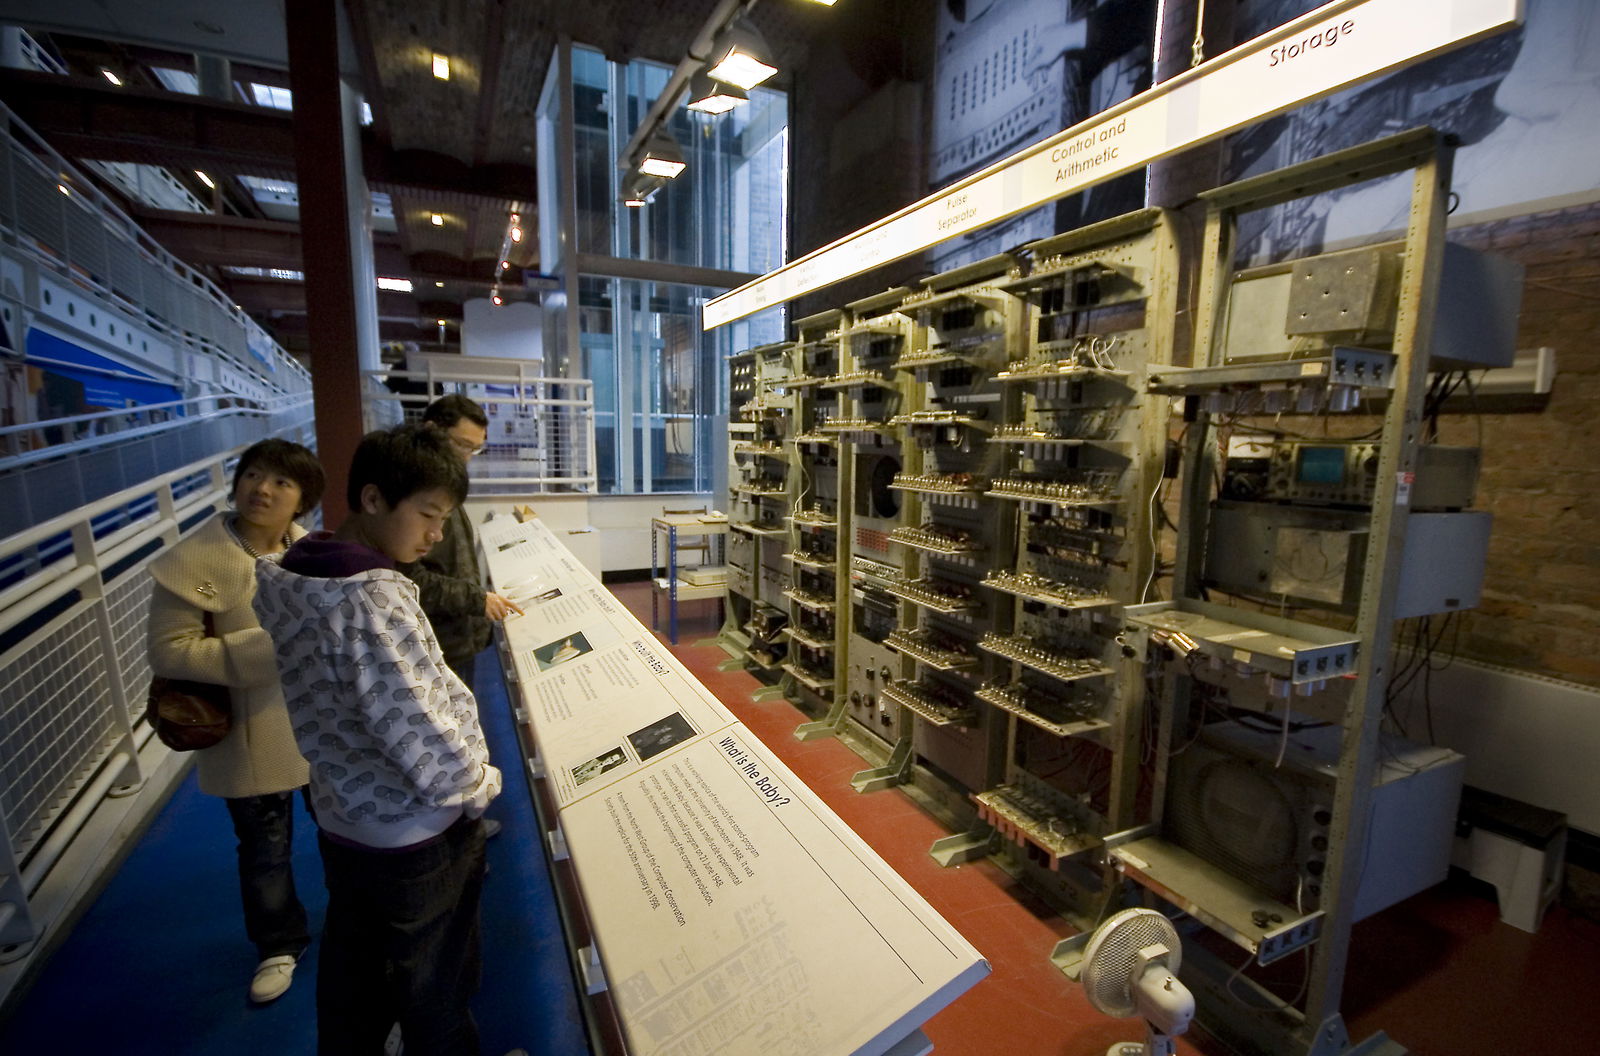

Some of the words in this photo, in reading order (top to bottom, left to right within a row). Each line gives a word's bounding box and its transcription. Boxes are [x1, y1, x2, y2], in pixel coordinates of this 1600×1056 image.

[1269, 20, 1354, 67] Storage
[1052, 132, 1096, 163] Control
[1099, 118, 1126, 142] and
[1056, 146, 1119, 182] Arithmetic
[938, 207, 977, 231] Separator
[719, 736, 744, 758] What
[735, 754, 748, 765] is
[742, 762, 760, 779] the
[755, 776, 791, 807] Baby?
[716, 803, 729, 817] world's
[726, 816, 735, 825] first
[729, 824, 759, 858] stored-program
[731, 847, 744, 861] 1948.
[629, 851, 639, 863] 50th
[701, 831, 721, 855] small-scale
[717, 853, 742, 886] experimental
[633, 862, 650, 890] anniversary
[681, 855, 698, 878] computer
[694, 875, 713, 906] revolution.
[703, 861, 715, 874] June
[711, 873, 724, 888] 1948.
[649, 894, 660, 911] 1998.
[653, 865, 668, 892] Computer
[664, 889, 686, 927] Conservation
